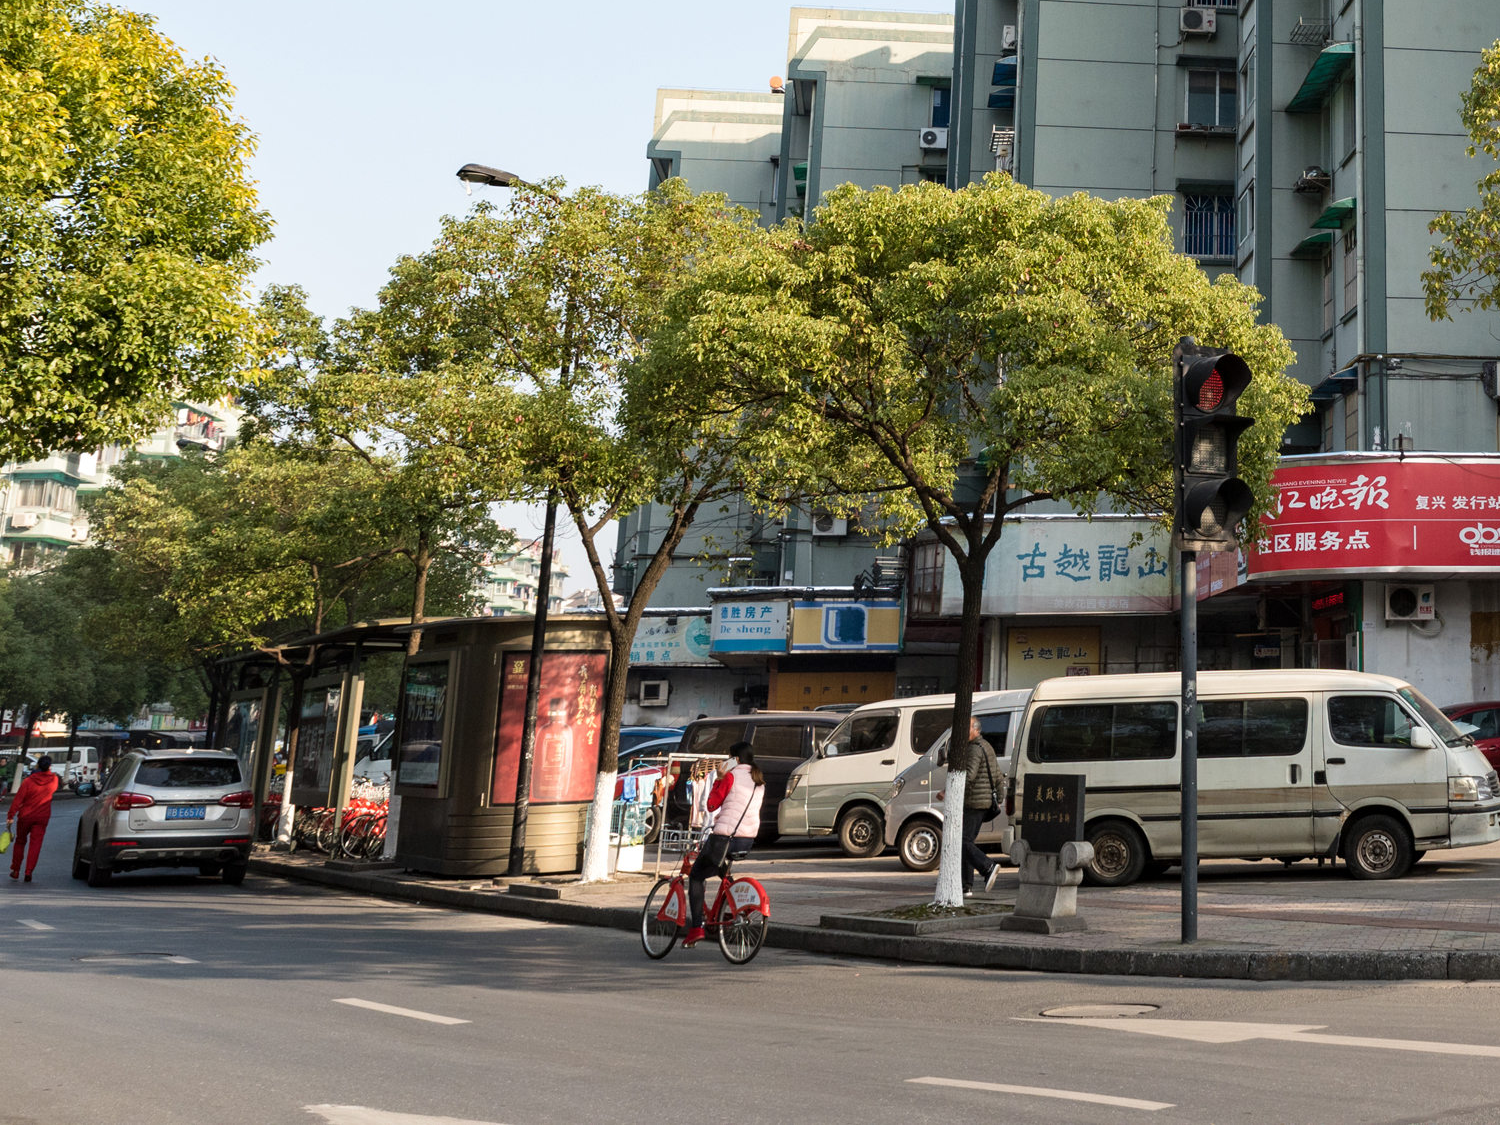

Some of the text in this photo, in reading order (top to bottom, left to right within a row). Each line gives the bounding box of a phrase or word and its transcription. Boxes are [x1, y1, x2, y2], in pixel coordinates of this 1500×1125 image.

[1415, 495, 1446, 510] 复兴
[1258, 530, 1371, 555] 社区服务点
[720, 605, 773, 619] 德胜房产
[720, 624, 732, 634] De
[736, 624, 772, 636] sheng
[630, 650, 671, 662] 销售点
[803, 685, 868, 695] 房产抵押
[1035, 784, 1066, 803] 美政桥
